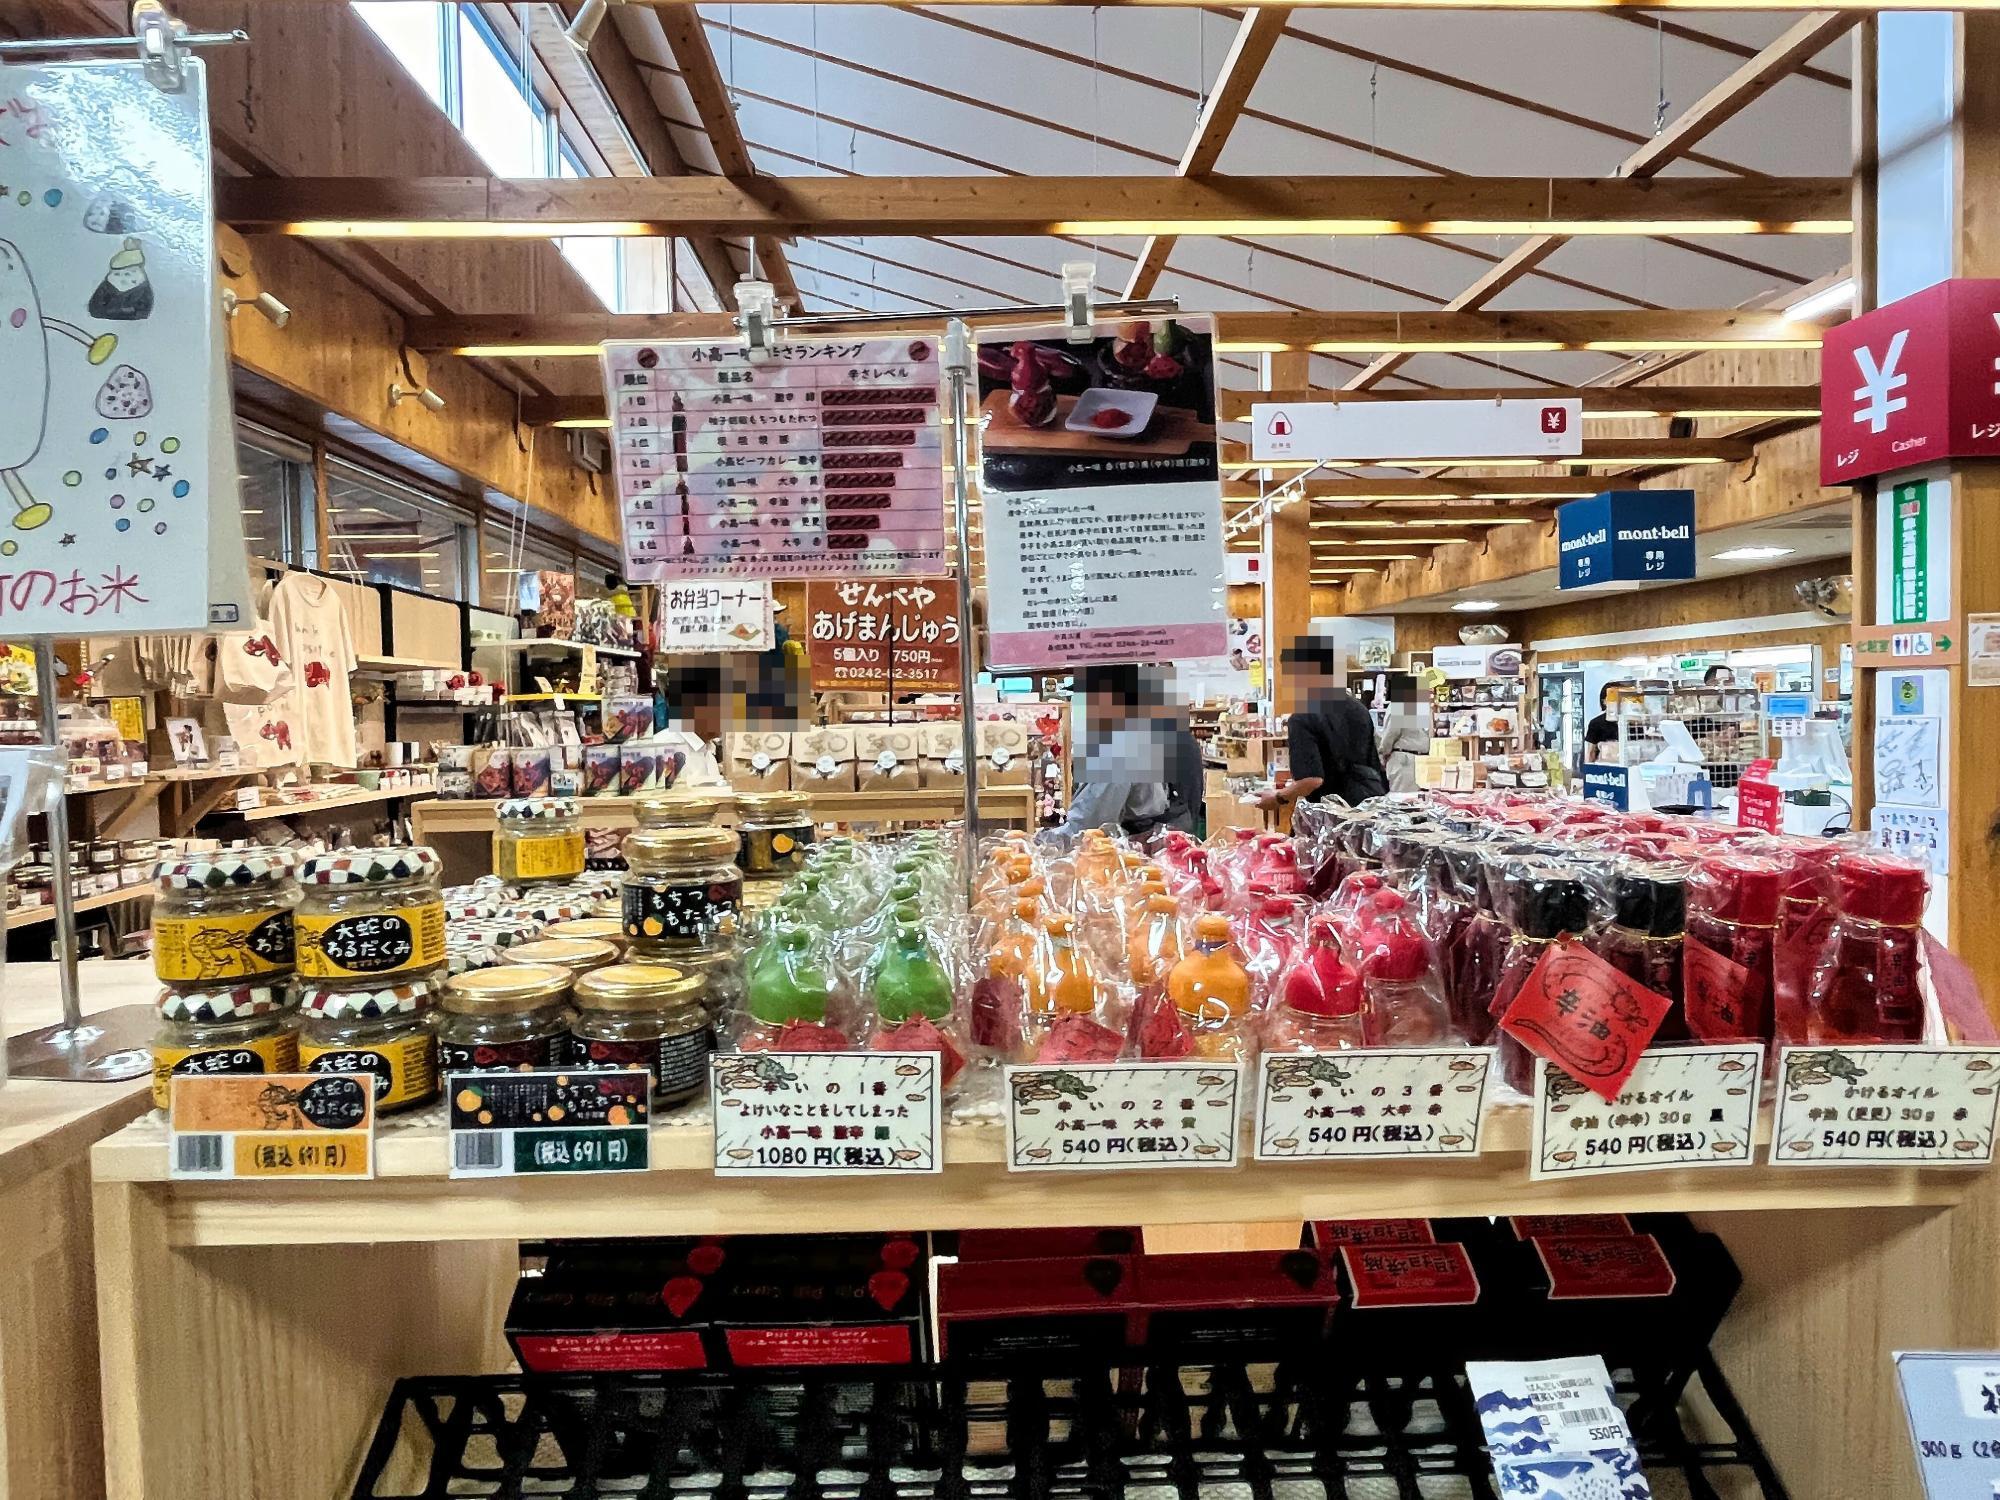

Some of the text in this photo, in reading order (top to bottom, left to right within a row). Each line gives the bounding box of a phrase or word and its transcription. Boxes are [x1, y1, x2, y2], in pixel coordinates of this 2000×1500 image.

[1837, 449, 1859, 467] レジ
[1645, 562, 1665, 571] レジ
[670, 587, 762, 610] お弁当コーナー
[812, 610, 960, 642] あげまんじゅう
[652, 890, 703, 910] もちつ
[1605, 1089, 1695, 1106] けるオイル
[1844, 1086, 1940, 1100] かけるオイル
[739, 1103, 910, 1118] よけいなことをしてしまった
